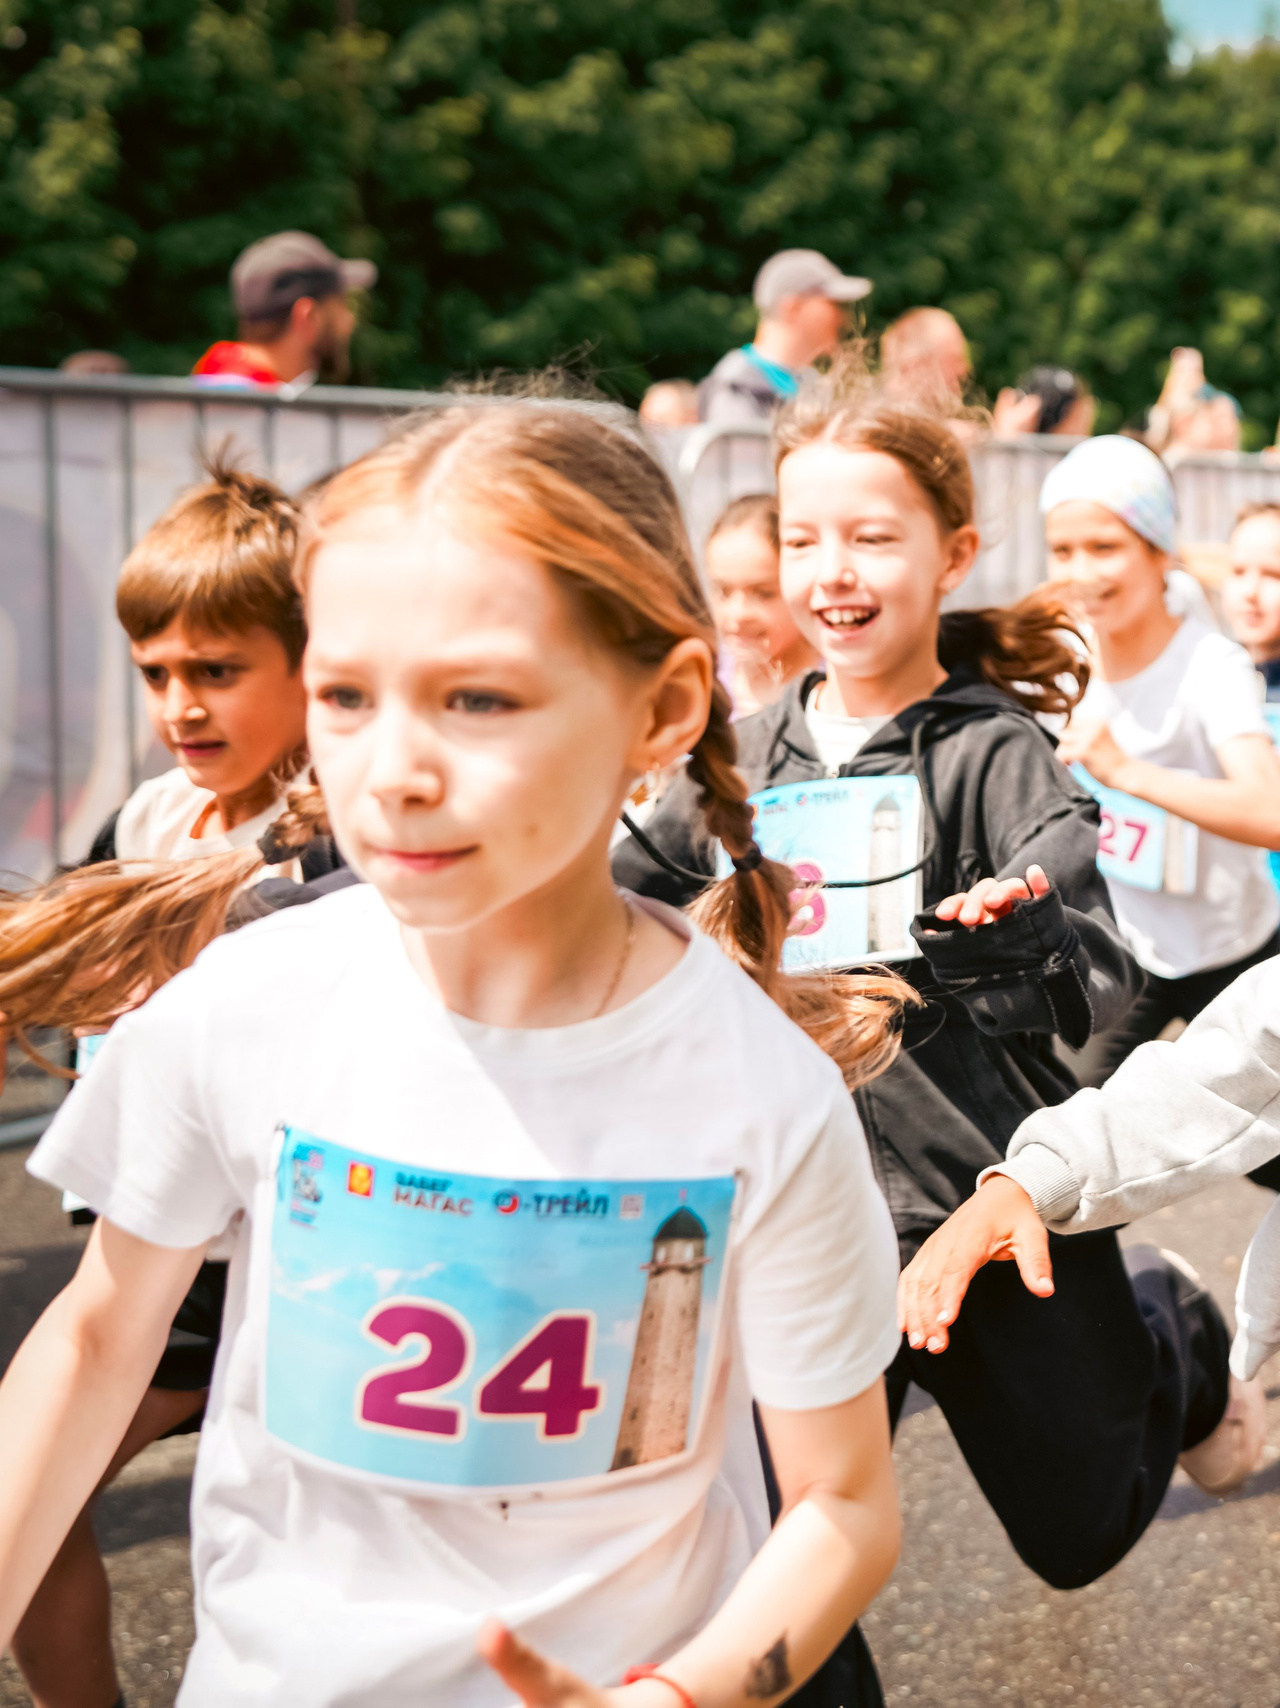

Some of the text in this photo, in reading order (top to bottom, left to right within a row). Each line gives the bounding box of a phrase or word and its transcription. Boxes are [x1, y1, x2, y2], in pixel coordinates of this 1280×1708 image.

[1098, 812, 1148, 862] 27
[394, 1184, 474, 1216] МАГАС
[359, 1302, 603, 1440] 24
